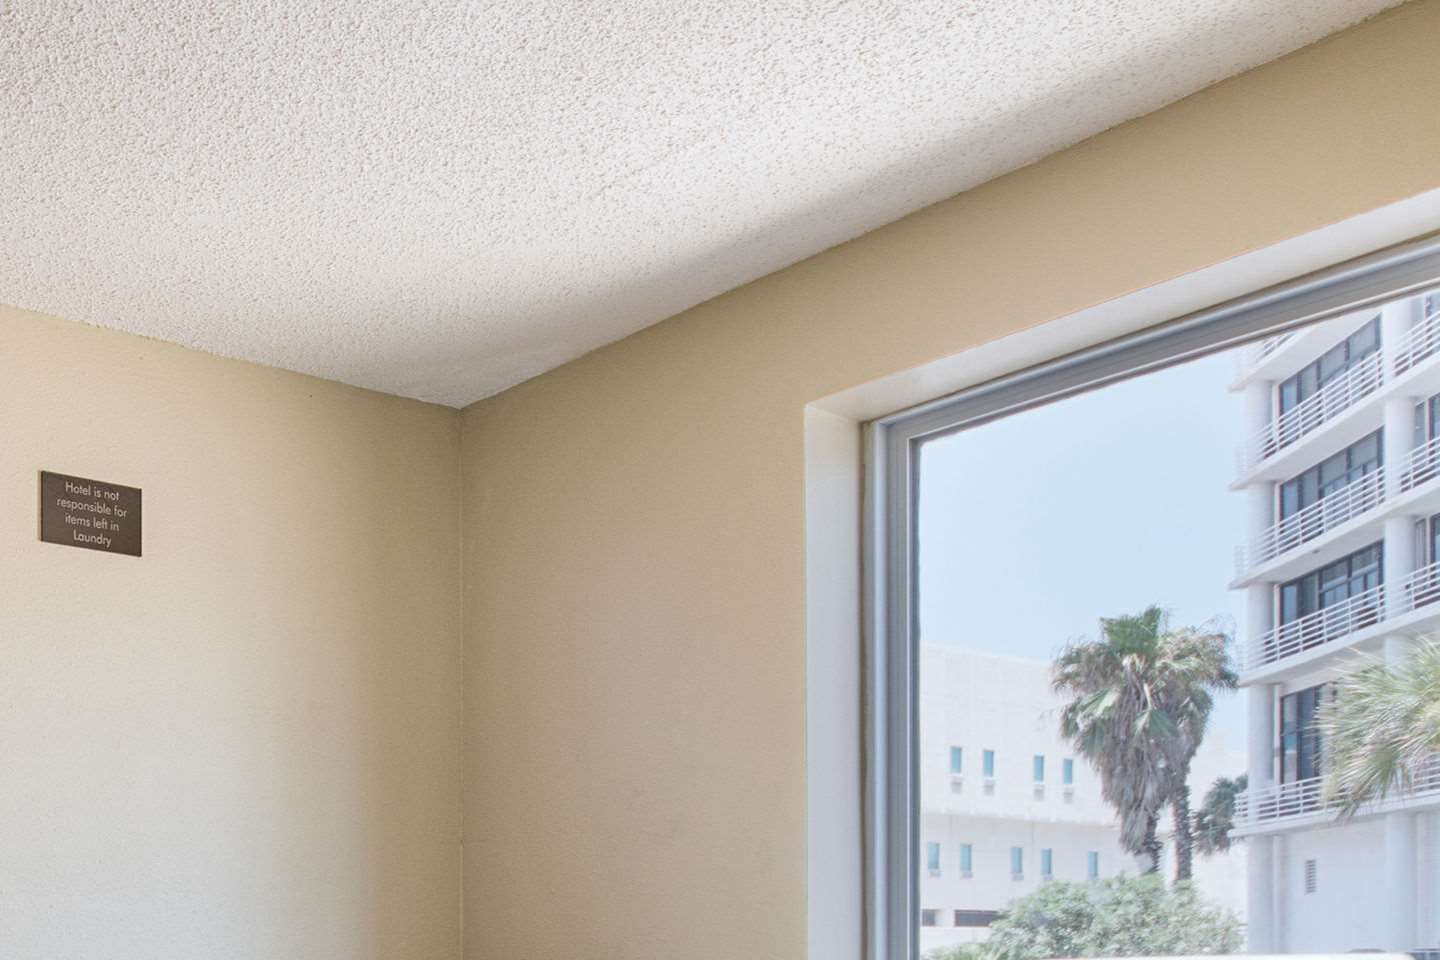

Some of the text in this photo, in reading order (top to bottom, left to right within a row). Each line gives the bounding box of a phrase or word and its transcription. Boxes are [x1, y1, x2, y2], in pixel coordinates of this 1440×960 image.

[65, 481, 120, 500] Hotel is not
[57, 499, 127, 517] responsible for
[65, 513, 119, 531] items left in
[73, 529, 111, 547] Laundry
